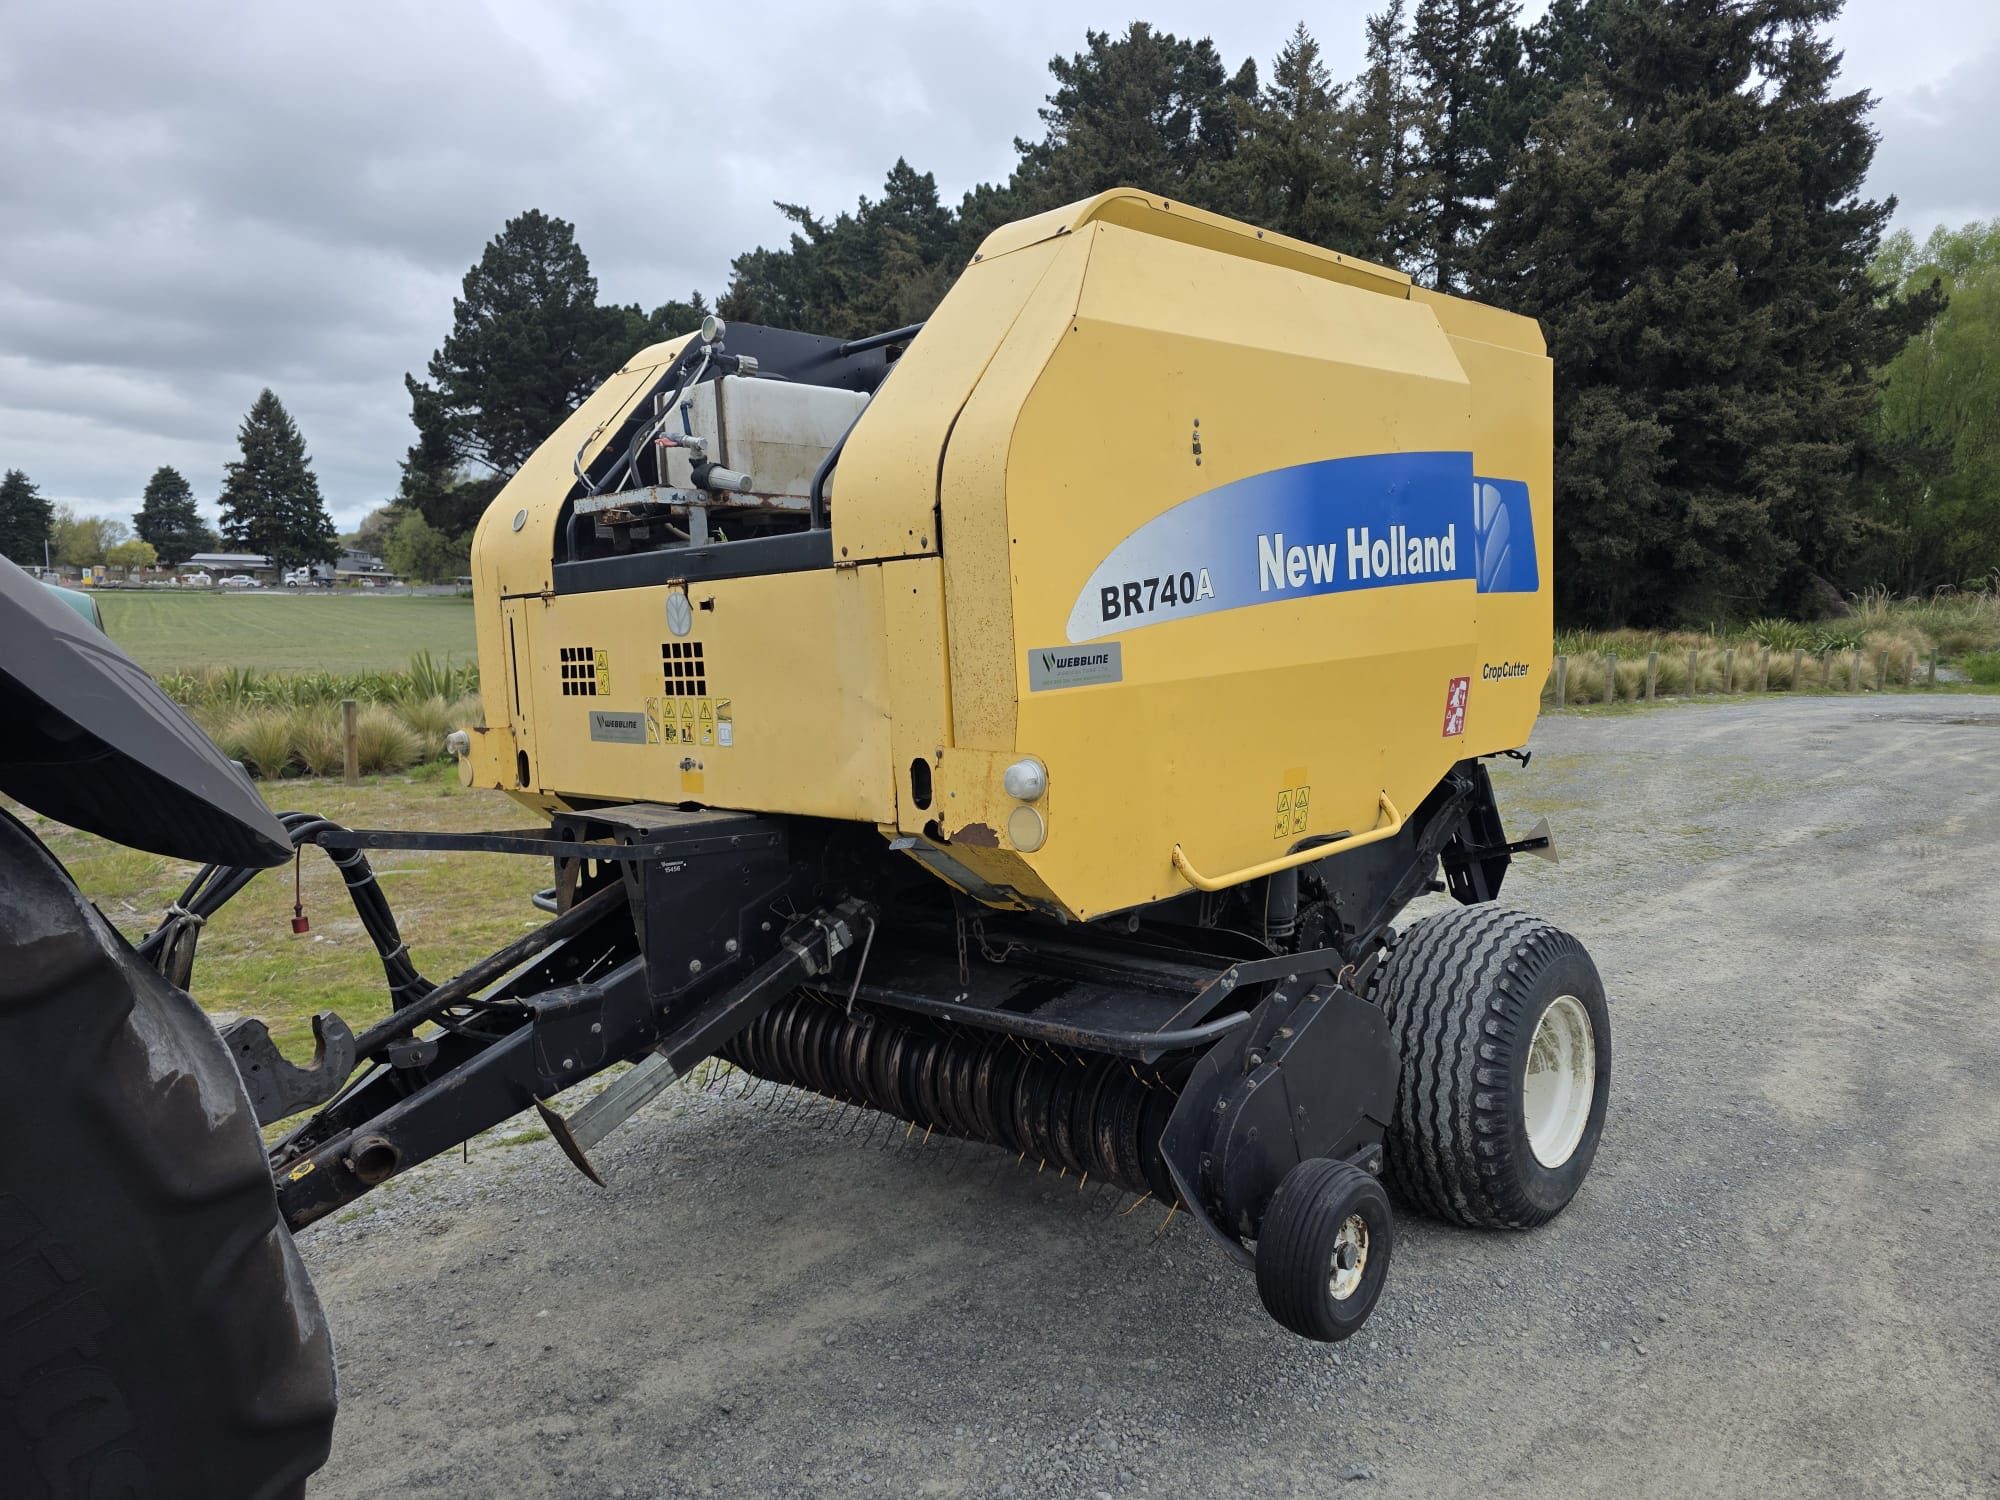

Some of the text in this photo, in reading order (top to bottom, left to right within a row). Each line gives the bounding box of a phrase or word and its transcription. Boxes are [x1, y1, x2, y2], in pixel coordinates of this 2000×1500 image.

[1257, 523, 1456, 593] New Holland
[1101, 567, 1215, 622] BR740A
[1056, 653, 1109, 669] WEBBLINE
[1482, 661, 1530, 682] CropCutter
